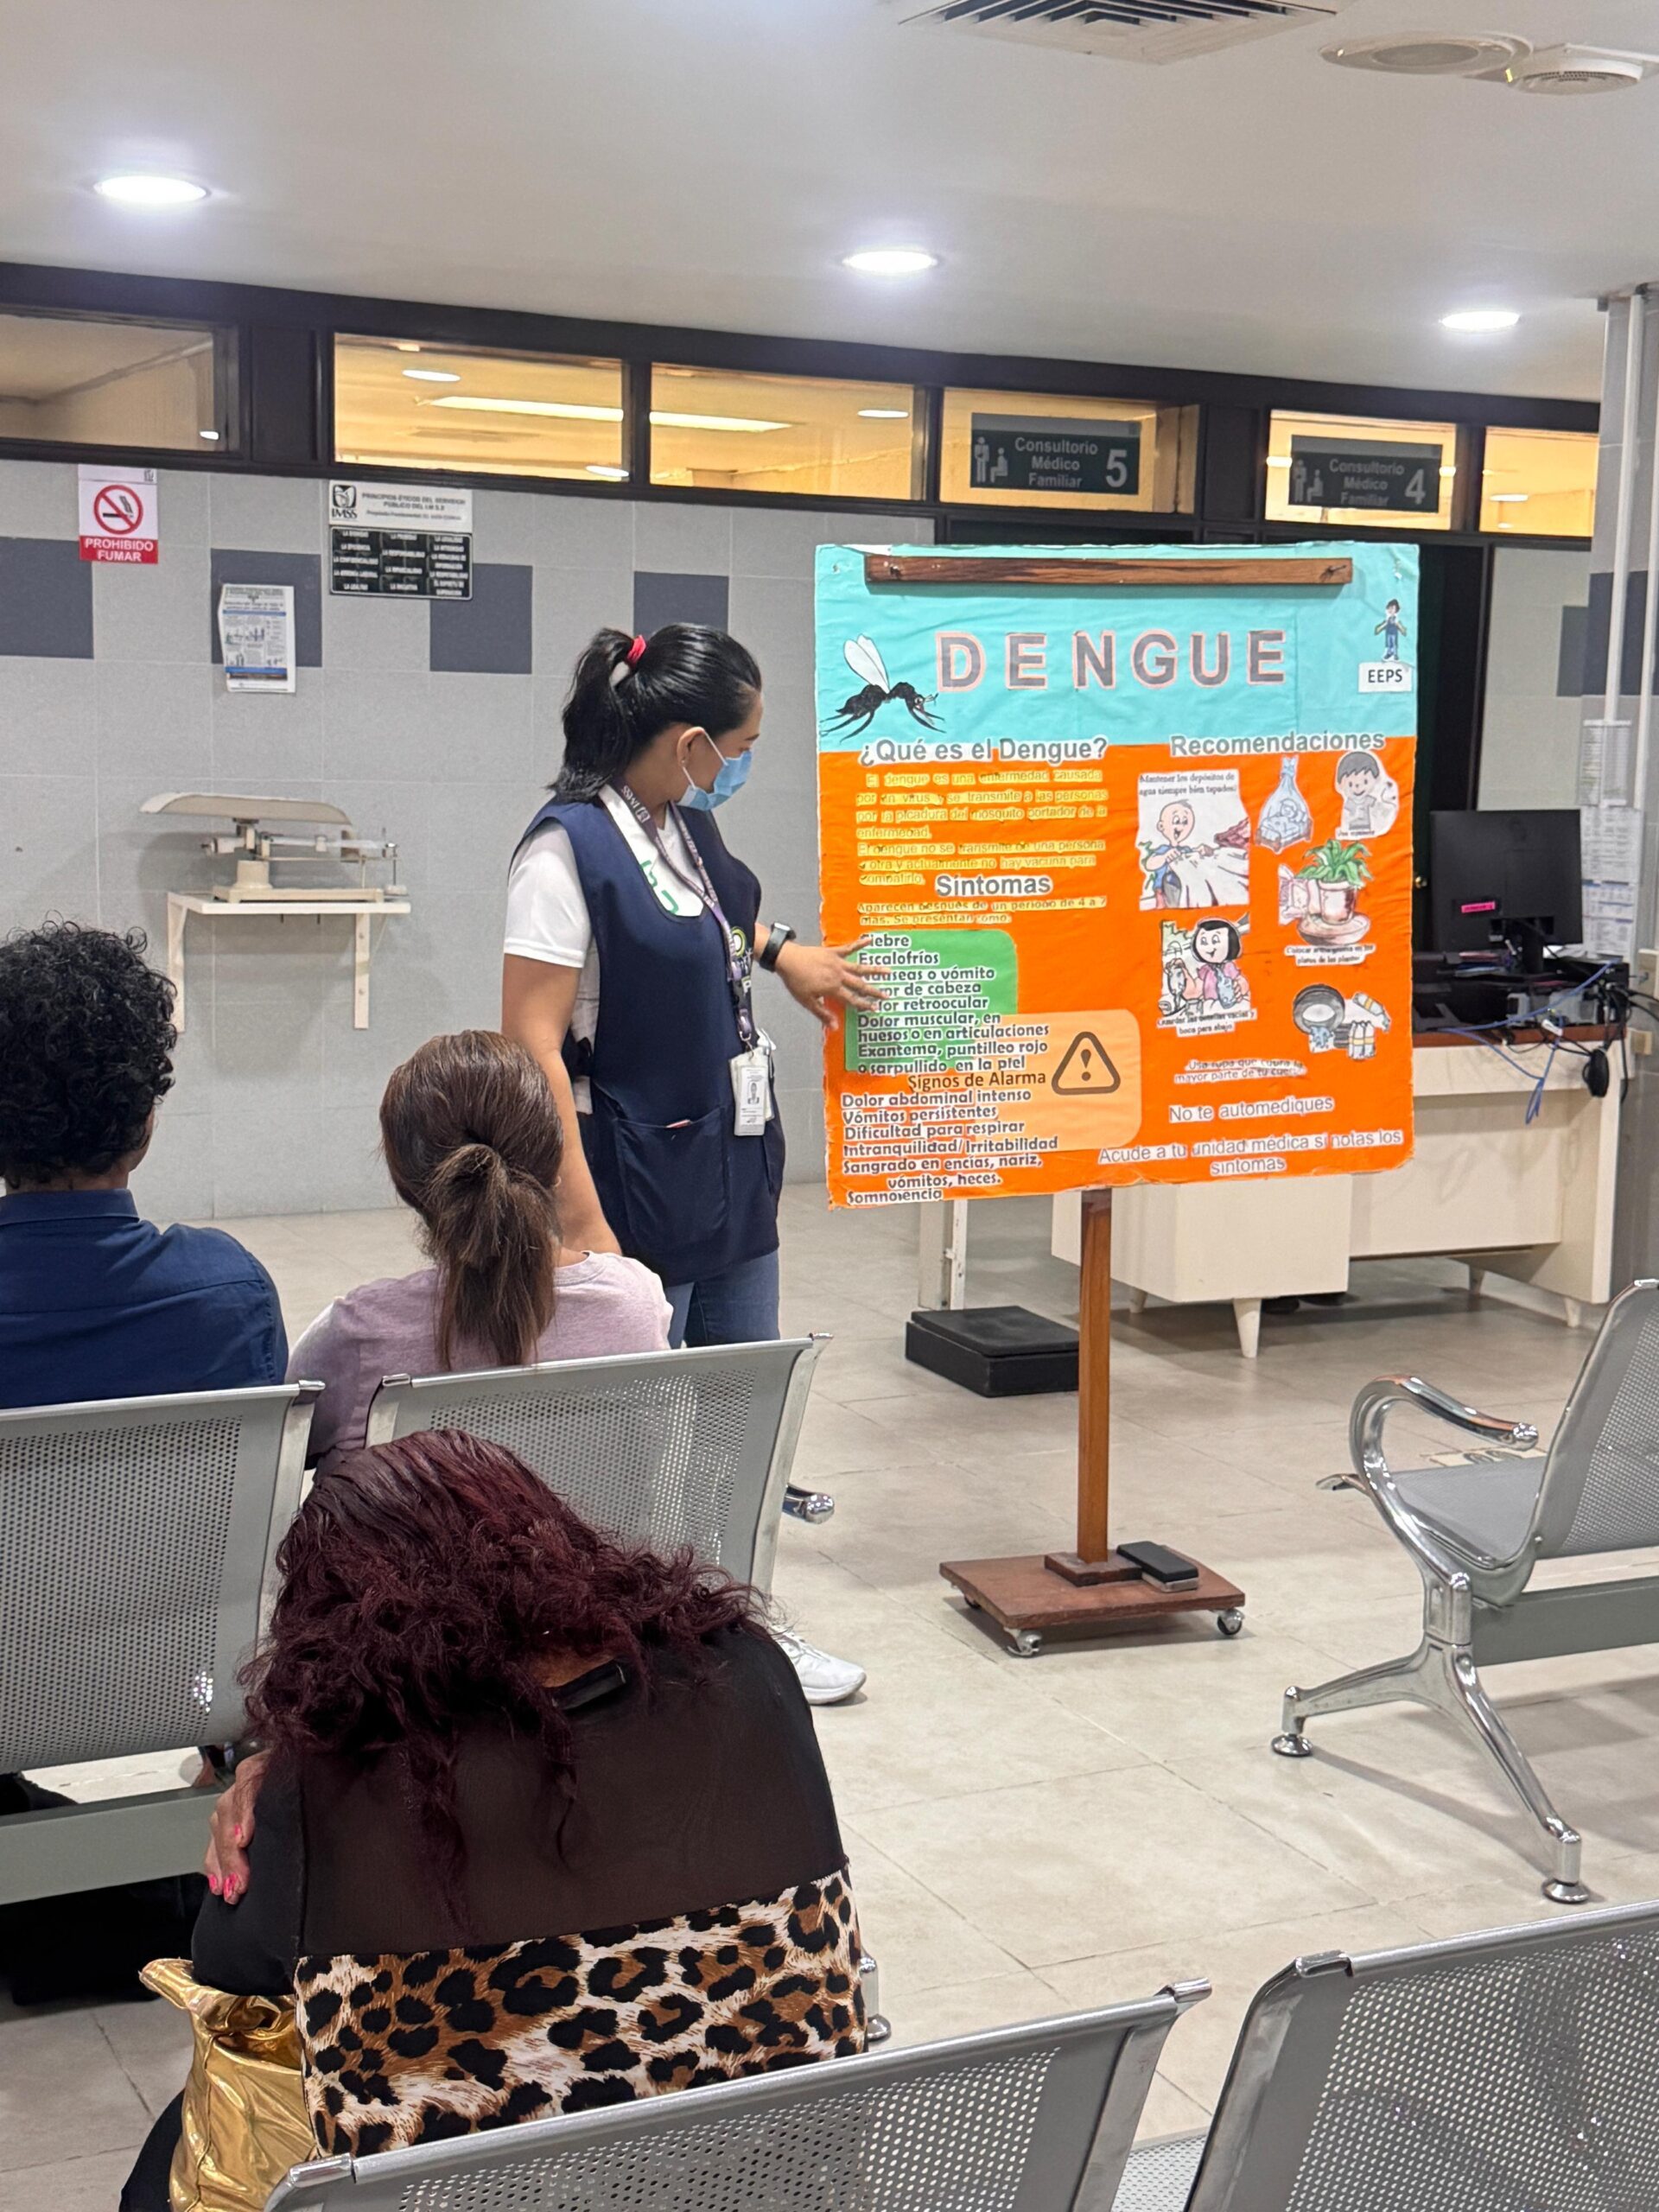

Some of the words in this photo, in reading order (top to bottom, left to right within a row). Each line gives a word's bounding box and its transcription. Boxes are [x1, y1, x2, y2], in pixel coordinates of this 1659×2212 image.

[1014, 436, 1098, 455] Consultorio
[1031, 455, 1080, 471] Médico
[1105, 448, 1128, 488] 5
[1329, 458, 1405, 476] Consultorio
[1028, 472, 1083, 488] Familiar
[1343, 476, 1389, 491] Médico
[1404, 468, 1427, 505] 4
[1340, 491, 1389, 506] Familiar
[331, 508, 358, 518] IMSS
[85, 537, 154, 552] PROHIBIDO
[97, 550, 142, 562] FUMAR
[937, 629, 1287, 692] DENGUE
[1368, 668, 1403, 683] EEPS
[861, 739, 926, 766] ¿Qué
[935, 745, 963, 760] es
[971, 738, 992, 760] el
[999, 737, 1107, 764] Dengue?
[1171, 731, 1384, 756] Recomendaciones
[884, 773, 929, 786] dengue
[934, 774, 949, 783] es
[952, 774, 974, 784] una
[1054, 769, 1102, 780] causada
[968, 791, 1021, 802] transmite
[1055, 790, 1108, 802] personas
[896, 809, 947, 822] picadura
[921, 844, 936, 853] no
[940, 843, 953, 852] se
[1058, 840, 1104, 853] persona
[982, 858, 996, 868] no
[1070, 855, 1095, 868] para
[937, 874, 1052, 897] Síntomas
[859, 950, 939, 965] Escalofríos
[927, 970, 937, 980] o
[941, 966, 995, 980] vómito
[904, 982, 923, 995] de
[927, 981, 982, 995] cabeza
[904, 996, 988, 1010] retroocular
[858, 1014, 899, 1028] Dolor
[905, 1012, 979, 1026] muscular,
[983, 1014, 1001, 1024] en
[858, 1029, 908, 1042] huesos
[911, 1029, 920, 1039] o
[924, 1029, 942, 1039] en
[946, 1024, 1049, 1039] articulaciones
[858, 1044, 942, 1057] Exantema,
[947, 1041, 1014, 1056] puntilleo
[1019, 1039, 1048, 1053] rojo
[858, 1064, 867, 1073] o
[870, 1059, 947, 1075] sarpullido
[956, 1061, 973, 1071] en
[978, 1058, 992, 1071] la
[998, 1055, 1025, 1070] piel
[908, 1074, 959, 1092] Signos
[964, 1073, 984, 1087] de
[989, 1071, 1046, 1086] Alarma
[842, 1094, 884, 1107] Dolor
[888, 1090, 973, 1105] abdominal
[977, 1090, 1032, 1103] intenso
[842, 1110, 905, 1123] Vómitos
[909, 1106, 996, 1122] persistentes
[1169, 1106, 1192, 1122] No
[1198, 1107, 1213, 1120] te
[1219, 1096, 1333, 1117] automediques
[845, 1123, 921, 1140] Dificultad
[927, 1125, 963, 1139] para
[966, 1121, 1025, 1135] respirar
[843, 1139, 963, 1156] Intranquilidad/
[966, 1135, 1058, 1153] Irritabilidad
[1099, 1146, 1151, 1163] Acude
[1156, 1146, 1166, 1159] a
[1172, 1144, 1186, 1158] tu
[1192, 1138, 1246, 1156] unidad
[1252, 1135, 1309, 1151] médica
[1332, 1131, 1374, 1147] notas
[1379, 1129, 1402, 1143] los
[843, 1158, 916, 1174] Sangrado
[921, 1160, 939, 1169] en
[944, 1154, 995, 1169] encías,
[999, 1154, 1042, 1166] nariz,
[888, 1175, 953, 1189] vómitos,
[957, 1173, 1001, 1185] heces.
